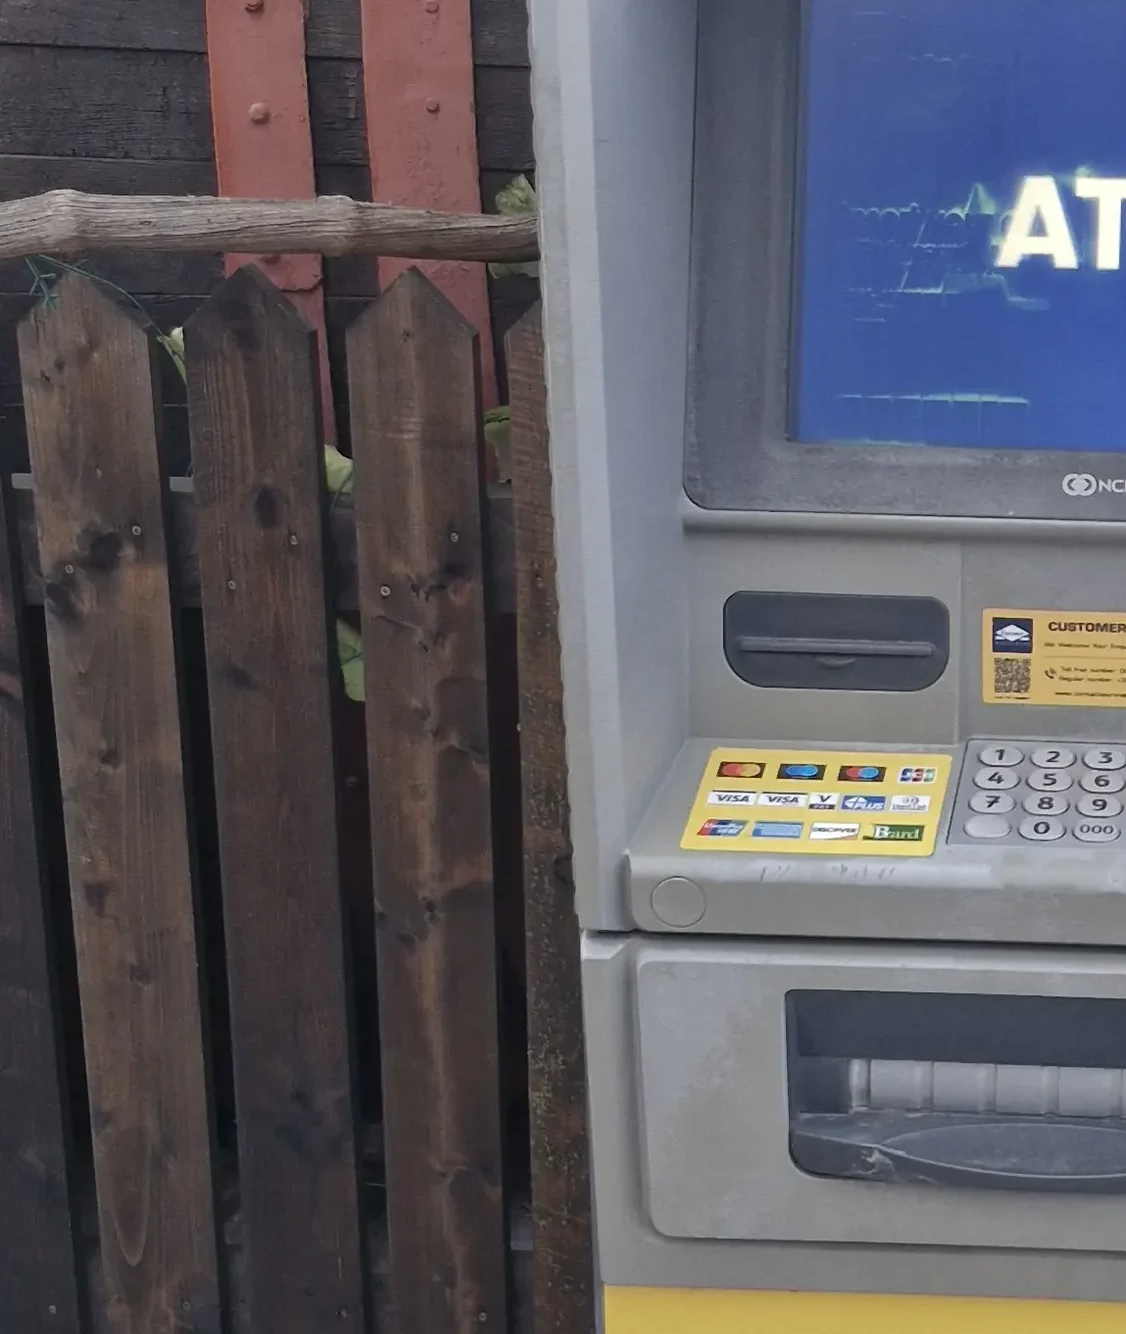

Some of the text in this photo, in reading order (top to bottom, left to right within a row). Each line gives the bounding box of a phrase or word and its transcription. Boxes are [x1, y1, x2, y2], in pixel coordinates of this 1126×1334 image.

[1048, 621, 1126, 633] CUSTOMER
[995, 748, 1005, 762] 1
[1046, 750, 1061, 763] 2
[1098, 751, 1113, 764] 3
[987, 772, 1004, 784] 4
[1043, 773, 1057, 786] 5
[1094, 775, 1109, 787] 6
[715, 794, 750, 803] VISA
[766, 795, 800, 804] VISA
[984, 795, 1002, 808] 7
[1037, 797, 1054, 810] 8
[1092, 799, 1107, 811] 9
[1033, 821, 1050, 834] 0
